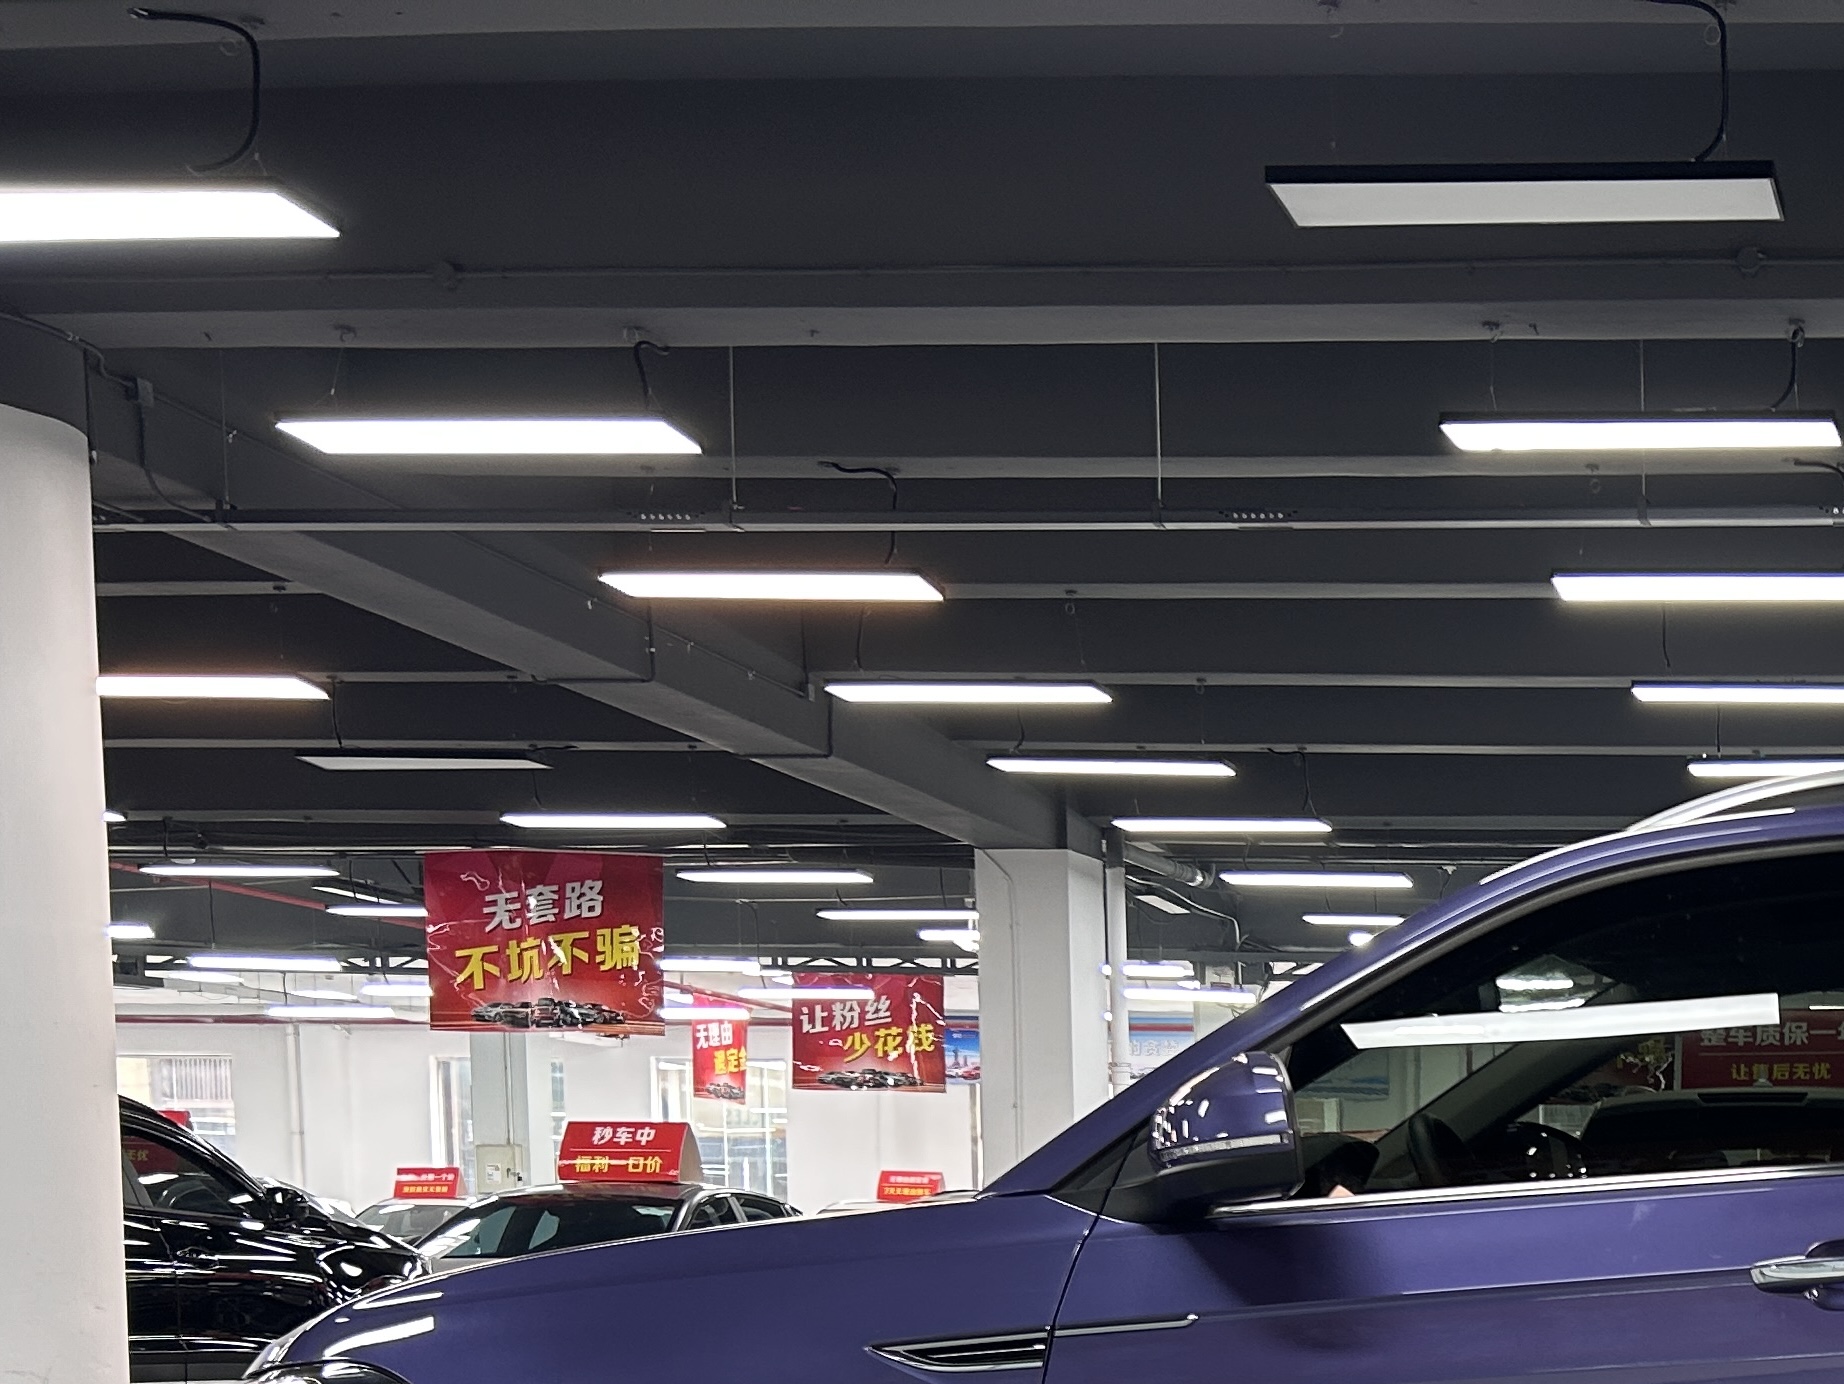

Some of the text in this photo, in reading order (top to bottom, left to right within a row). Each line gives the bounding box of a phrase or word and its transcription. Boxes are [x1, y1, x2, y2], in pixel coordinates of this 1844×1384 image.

[482, 880, 604, 933] 无套路
[454, 924, 642, 991] 不坑不骗
[800, 995, 893, 1034] 让粉丝
[695, 1020, 733, 1050] 无理由
[591, 1126, 656, 1146] 秒车中
[574, 1156, 663, 1174] 福利一口价
